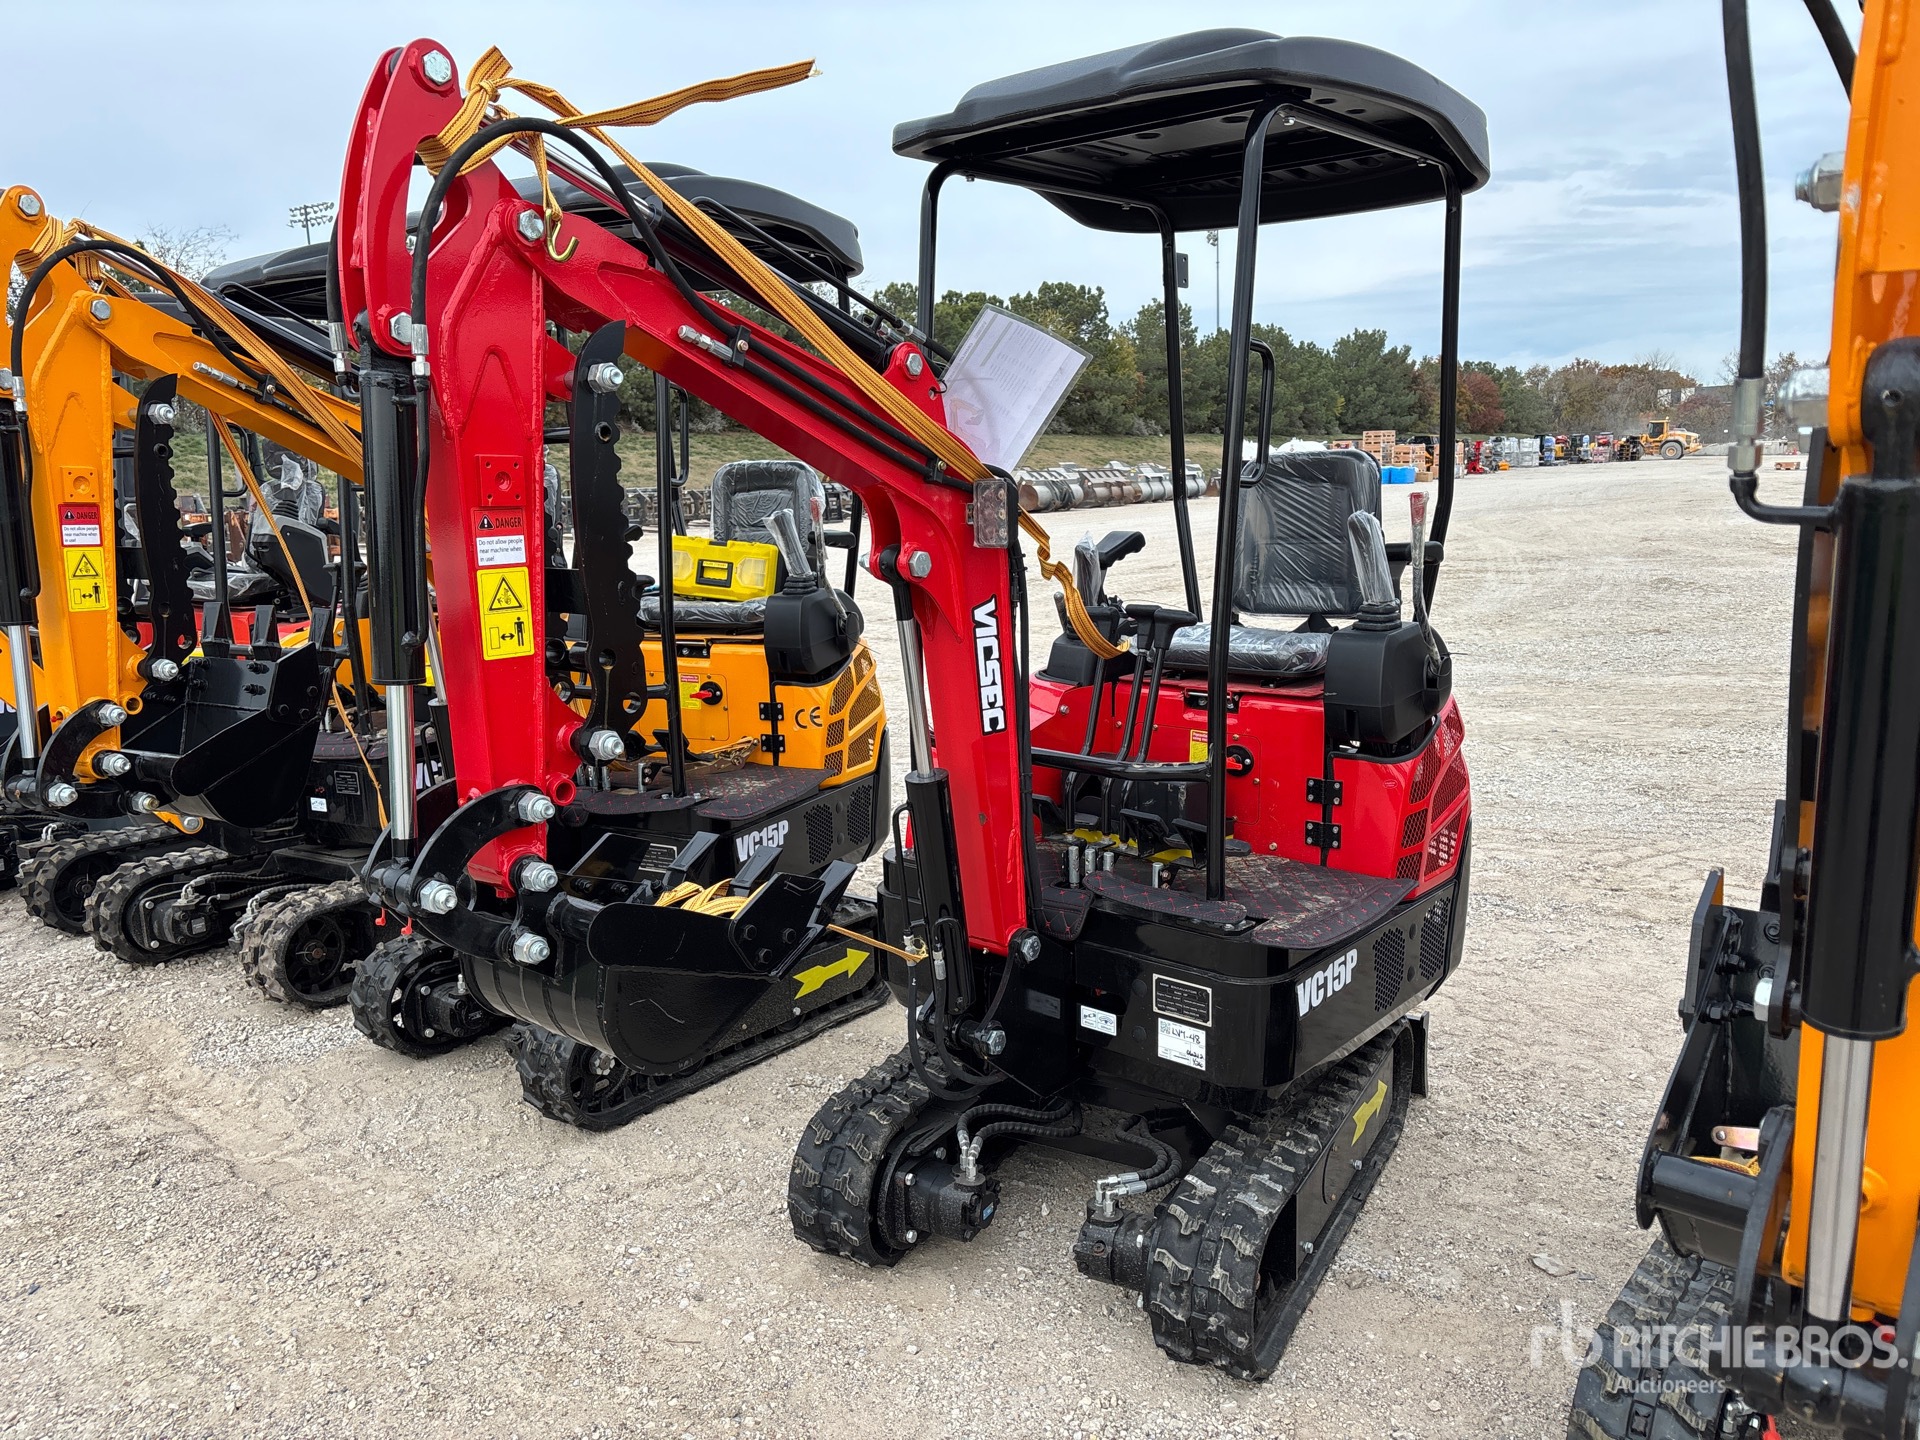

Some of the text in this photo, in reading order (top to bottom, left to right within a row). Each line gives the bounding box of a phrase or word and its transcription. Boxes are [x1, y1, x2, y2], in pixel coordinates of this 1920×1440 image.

[77, 512, 97, 520] DANGER
[495, 517, 522, 528] DANGER
[973, 595, 1006, 735] VICSEC
[736, 820, 789, 862] VC15P
[1297, 948, 1358, 1017] VC15P
